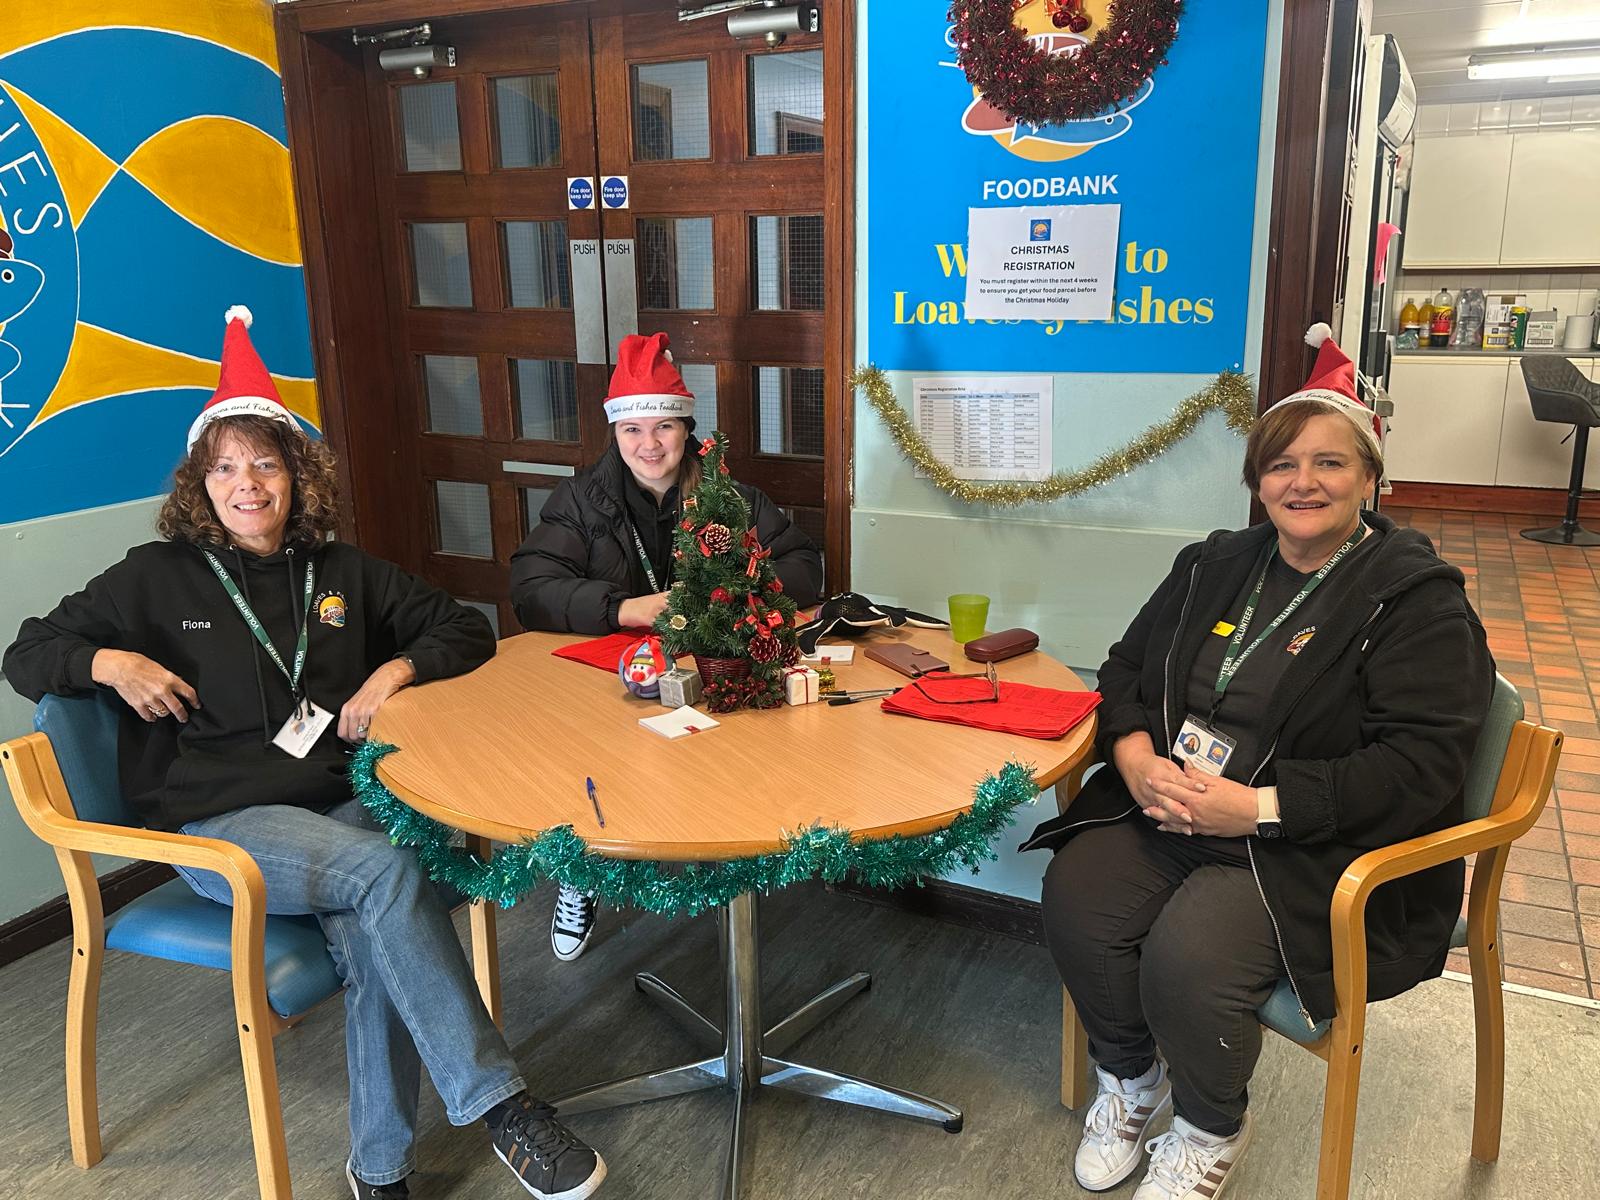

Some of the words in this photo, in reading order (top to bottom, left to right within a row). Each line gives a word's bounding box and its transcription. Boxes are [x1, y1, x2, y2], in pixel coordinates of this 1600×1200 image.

[983, 174, 1118, 200] FOODBANK
[573, 244, 596, 255] PUSH
[607, 243, 630, 255] PUSH
[1010, 245, 1070, 255] CHRISTMAS
[1126, 241, 1168, 274] to
[1003, 261, 1075, 271] REGISTRATION
[231, 403, 250, 411] and
[252, 402, 280, 416] Fishes
[636, 402, 657, 411] Fishes
[1315, 541, 1354, 579] VOLUNTEER
[232, 593, 260, 630] VOLUNTEER
[1271, 590, 1309, 627] VOLUNTEER
[182, 620, 211, 630] Fiona
[1232, 606, 1255, 644] VOLUNTEER
[1226, 638, 1262, 677] VOLUNTEER
